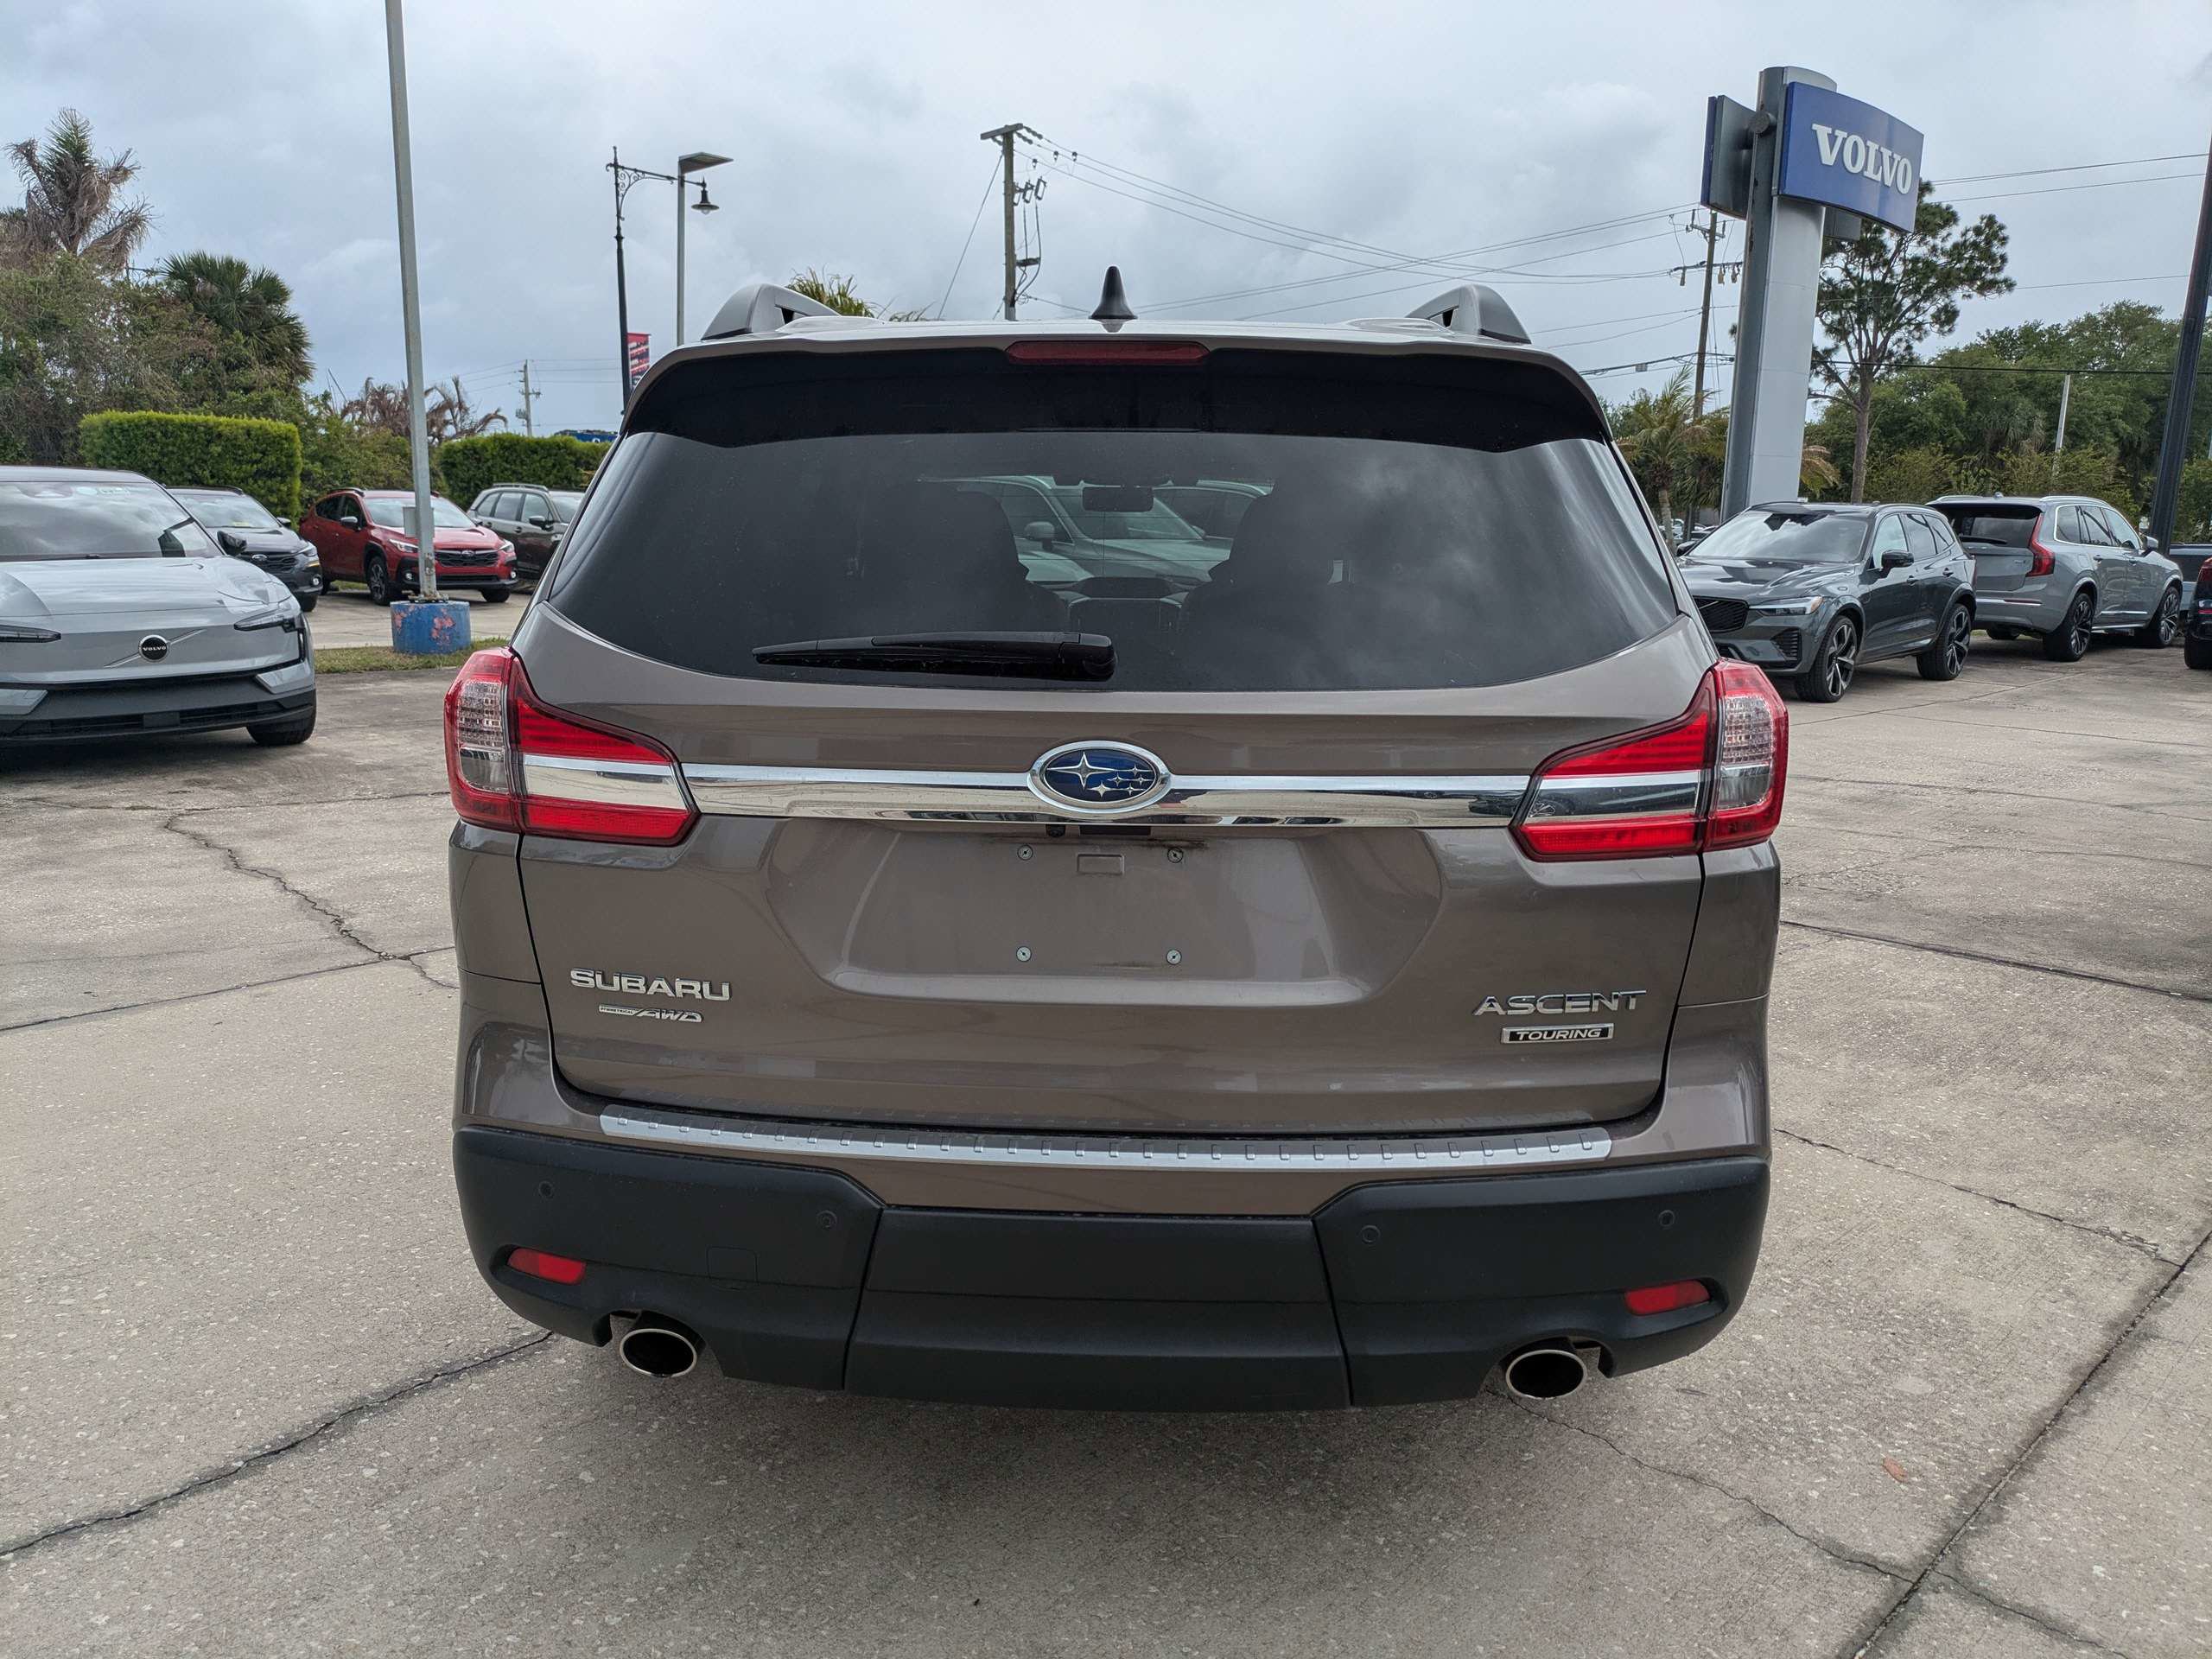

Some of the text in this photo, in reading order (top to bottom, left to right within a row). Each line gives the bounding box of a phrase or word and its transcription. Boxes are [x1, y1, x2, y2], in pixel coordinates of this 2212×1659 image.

[1811, 123, 1912, 194] VOLVO
[569, 968, 731, 1001] SUBARU
[637, 1007, 703, 1023] AWD
[1473, 989, 1647, 1016] ASCENT
[1516, 1028, 1602, 1040] TOURING
